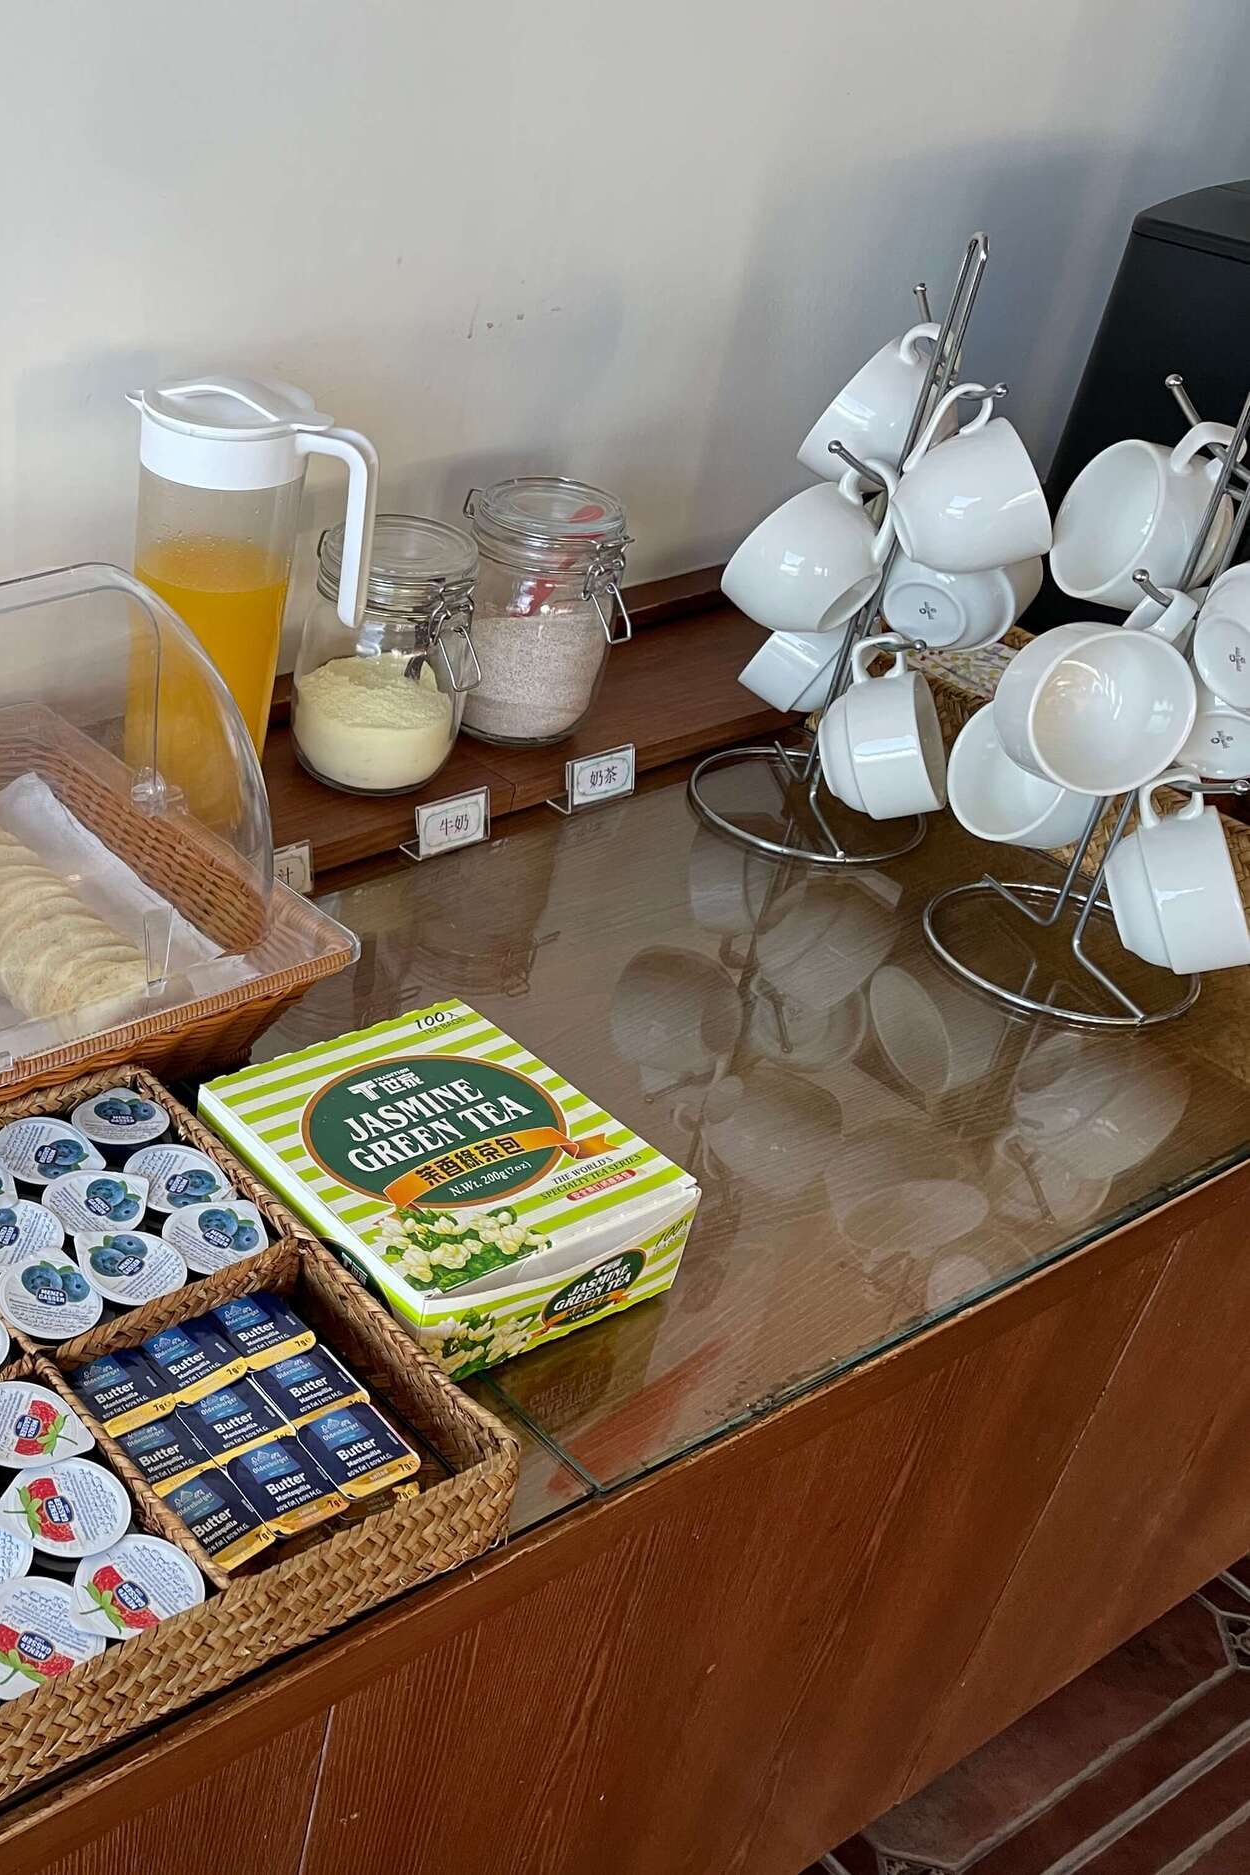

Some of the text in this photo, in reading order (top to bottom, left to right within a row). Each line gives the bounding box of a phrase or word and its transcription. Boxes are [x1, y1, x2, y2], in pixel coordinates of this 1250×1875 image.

[589, 765, 618, 788] 奶茶
[439, 814, 469, 837] 牛奶
[343, 1078, 485, 1142] JASMINE
[347, 1095, 534, 1172] GREEN TEA
[540, 1175, 591, 1200] SPECIALTY
[552, 1173, 574, 1185] THE
[553, 1285, 606, 1311] GREEN
[605, 1272, 632, 1291] TEA
[567, 1263, 631, 1297] JASMINE
[237, 1322, 275, 1342] Butter
[168, 1351, 205, 1375] Butter
[94, 1382, 134, 1404] Butter
[289, 1377, 328, 1397] Butter
[213, 1413, 253, 1434] Butter
[139, 1444, 180, 1466] Butter
[336, 1438, 376, 1461] Butter
[265, 1472, 306, 1495] Butter
[191, 1508, 232, 1538] Butter
